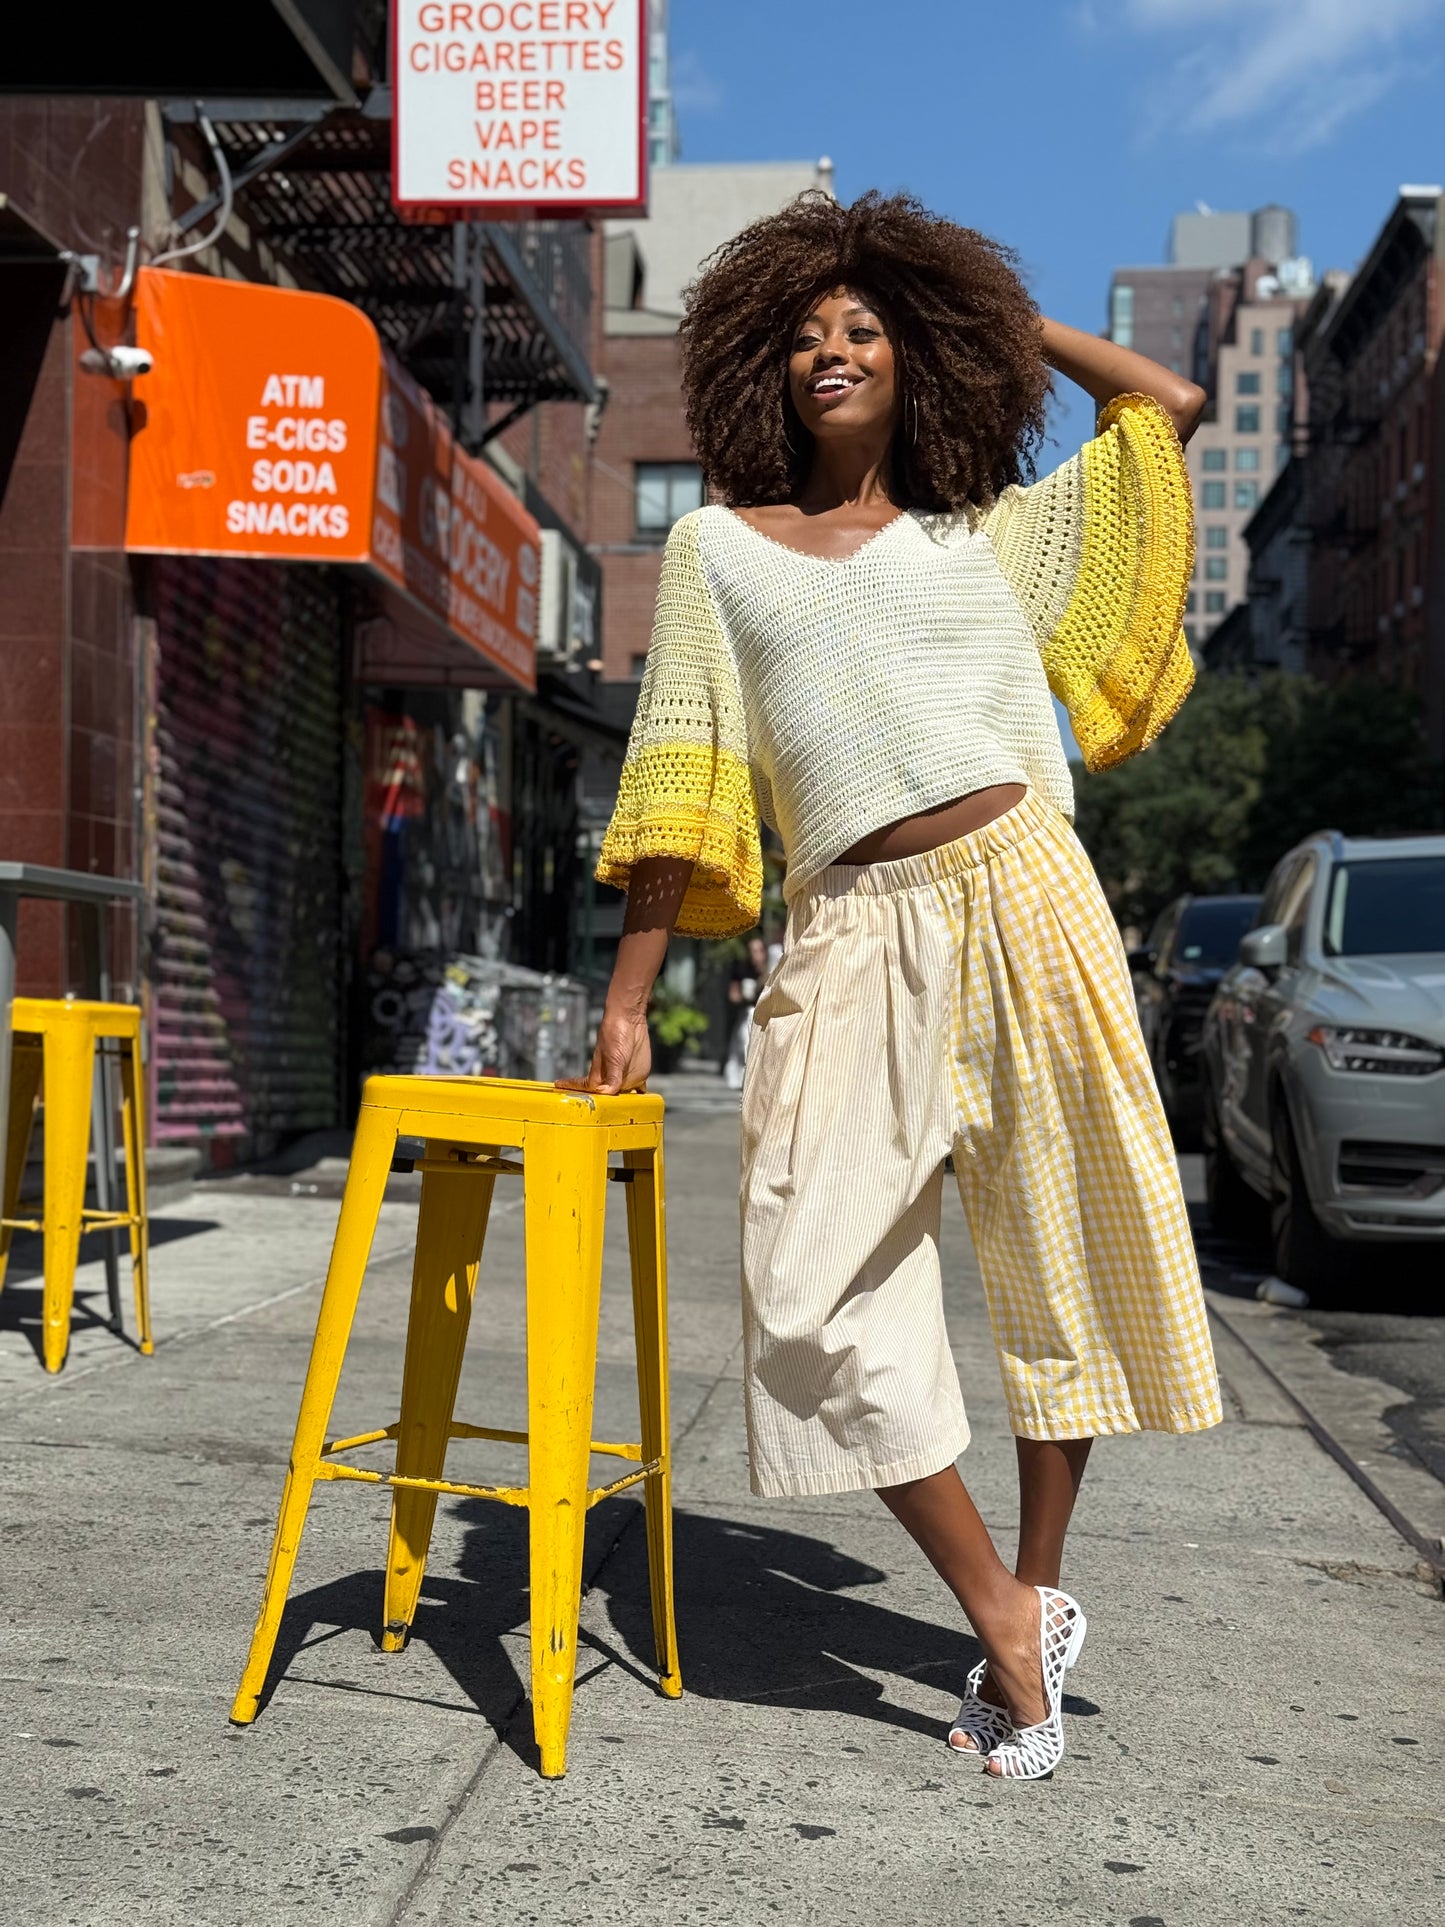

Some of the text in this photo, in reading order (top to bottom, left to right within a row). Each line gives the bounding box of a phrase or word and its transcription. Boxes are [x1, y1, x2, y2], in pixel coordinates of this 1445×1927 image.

[418, 1, 615, 32] GROCERY
[410, 40, 624, 72] CIGARETTES
[476, 81, 566, 110] BEER
[474, 120, 562, 150] VAPE
[447, 159, 587, 189] SNACKS
[261, 374, 324, 408] ATM
[246, 416, 347, 453] E-CIGS
[252, 459, 337, 494] SODA
[226, 501, 349, 538] SNACKS
[419, 476, 511, 614] GROCERY
